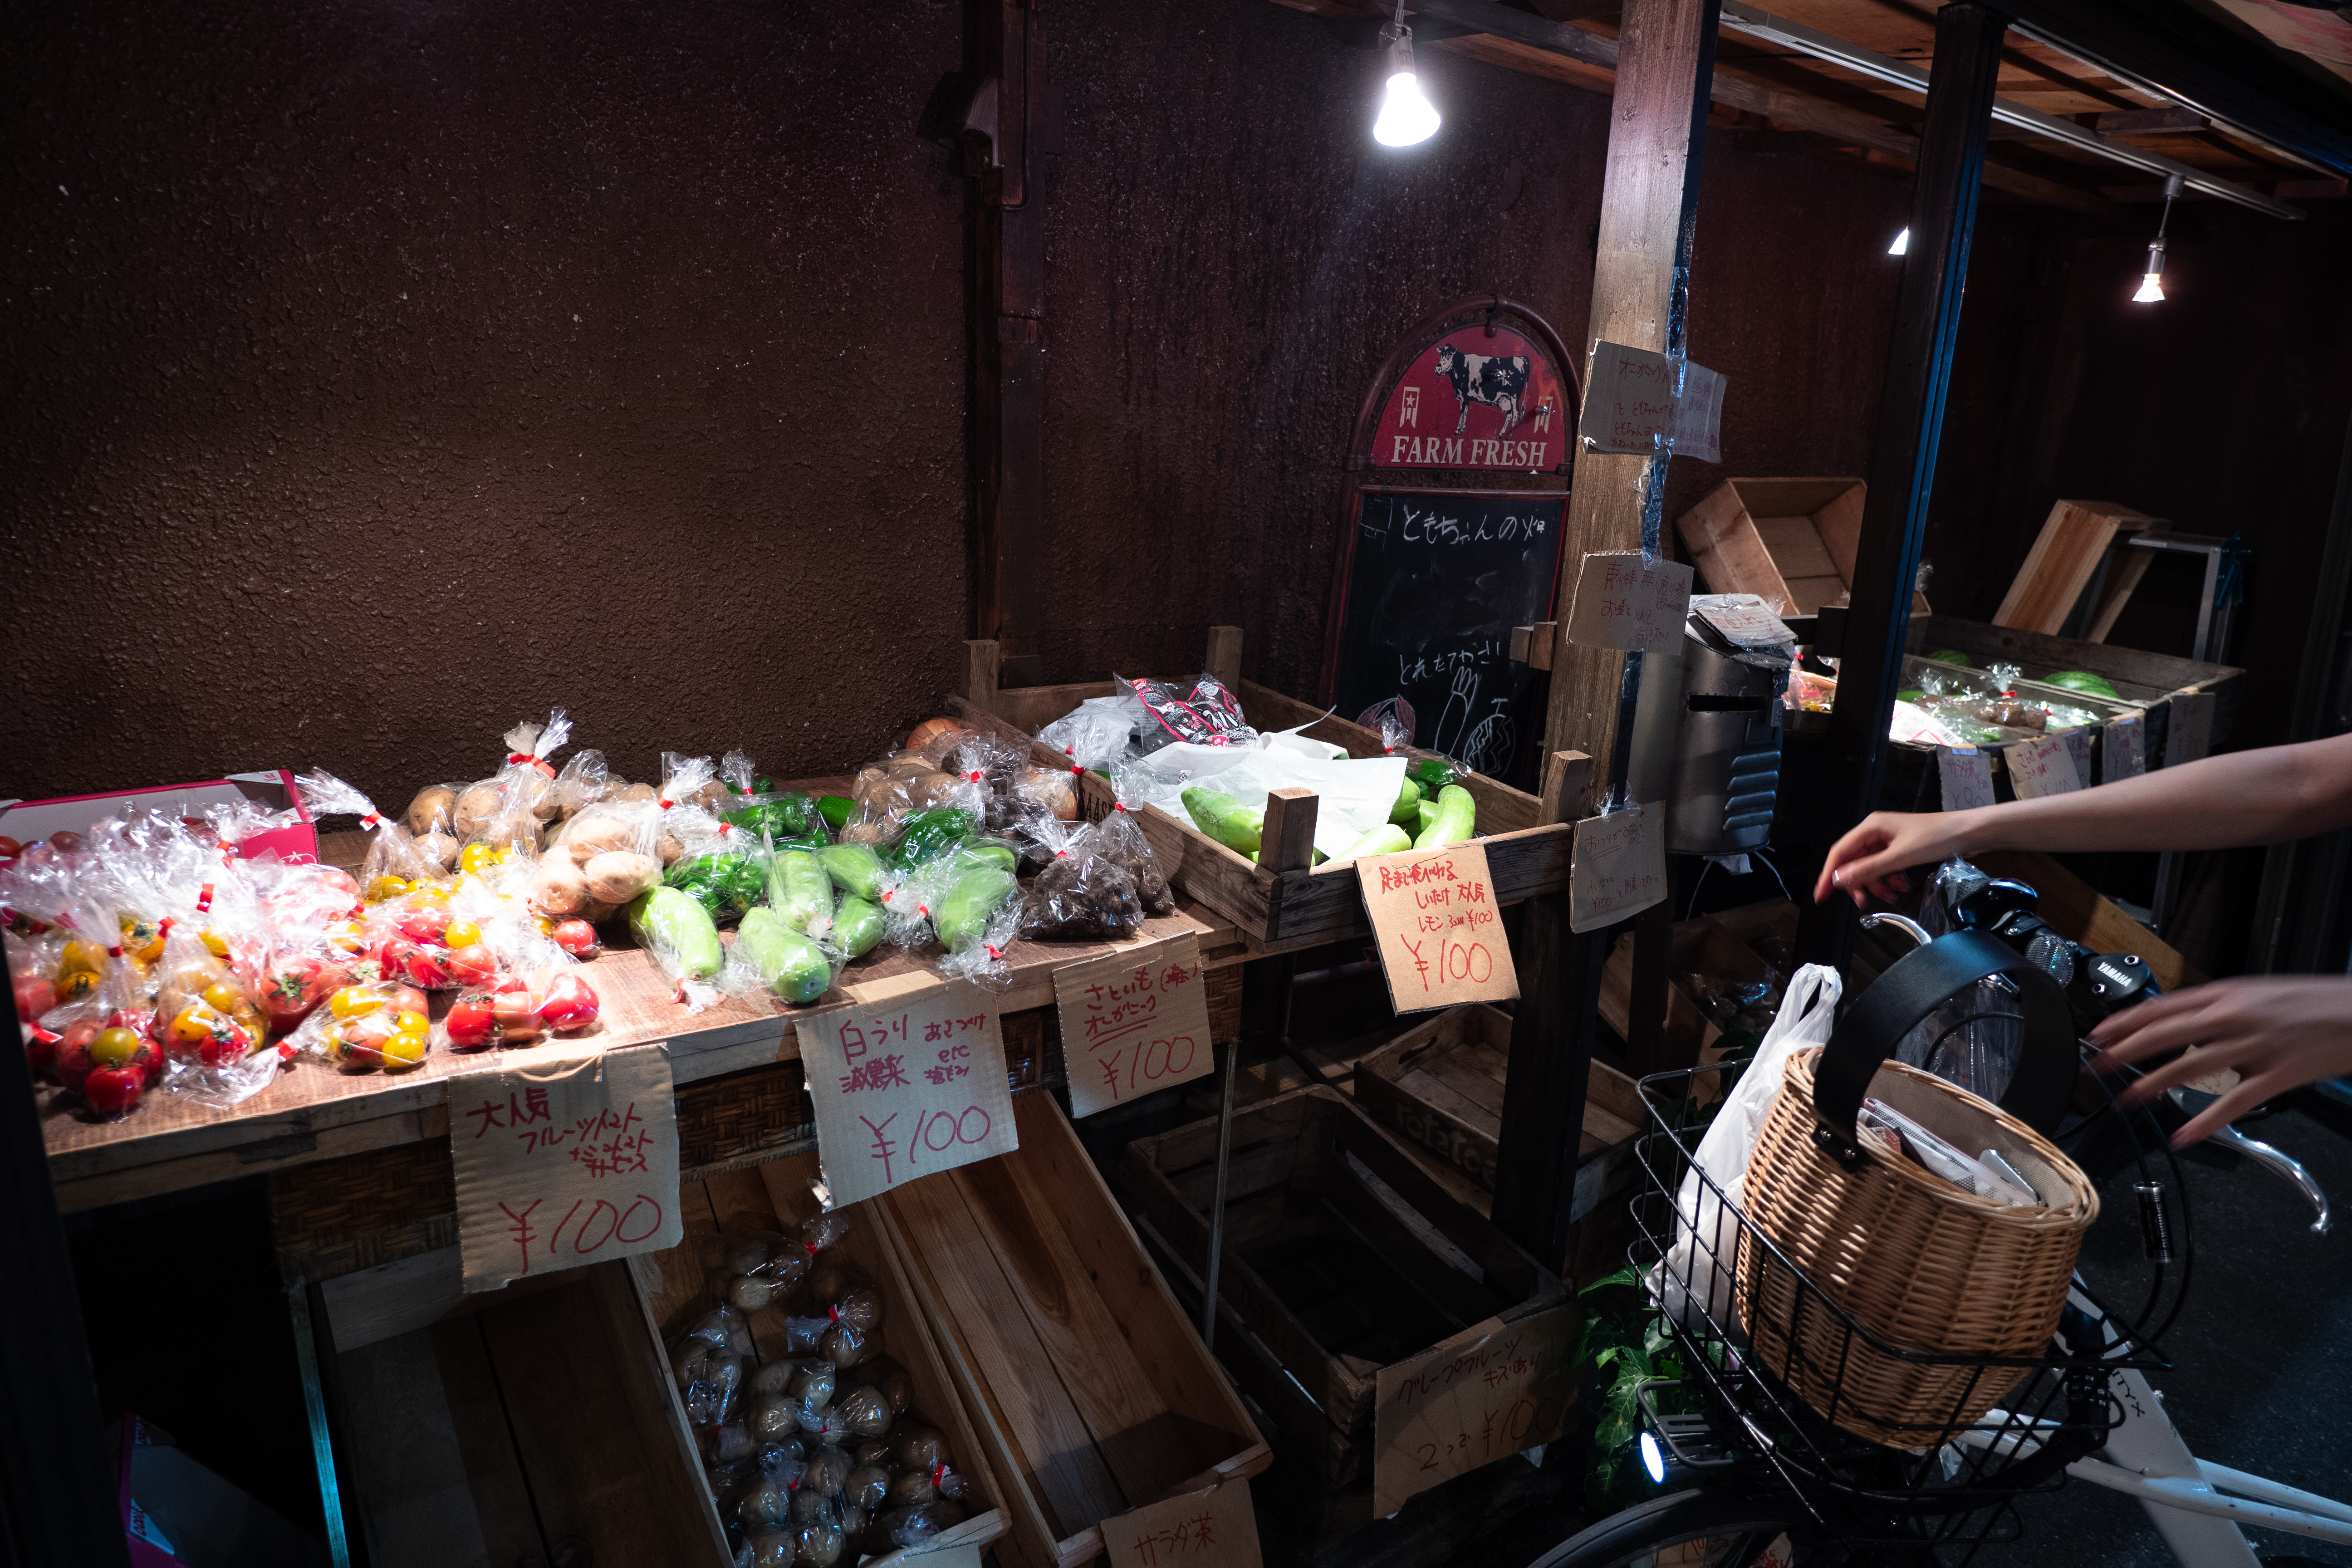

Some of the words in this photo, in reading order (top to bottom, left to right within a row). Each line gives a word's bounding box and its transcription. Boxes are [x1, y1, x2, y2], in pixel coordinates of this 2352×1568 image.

[1391, 436, 1465, 465] FARM
[1469, 439, 1547, 467] FRESH
[1416, 887, 1450, 909] しいたけ
[1419, 916, 1443, 932] レモン
[1401, 934, 1492, 992] ¥100
[2097, 961, 2132, 987] YAMAHA
[839, 1013, 908, 1065] 白うり
[938, 1045, 970, 1063] etc
[839, 1054, 911, 1094] 減農薬
[1099, 1037, 1195, 1100] ¥100
[466, 1088, 552, 1138] 大人気
[859, 1106, 991, 1184] ¥100
[499, 1194, 662, 1275] ¥100
[1482, 1397, 1563, 1458] ¥100
[1134, 1511, 1216, 1567] サラダ菜
